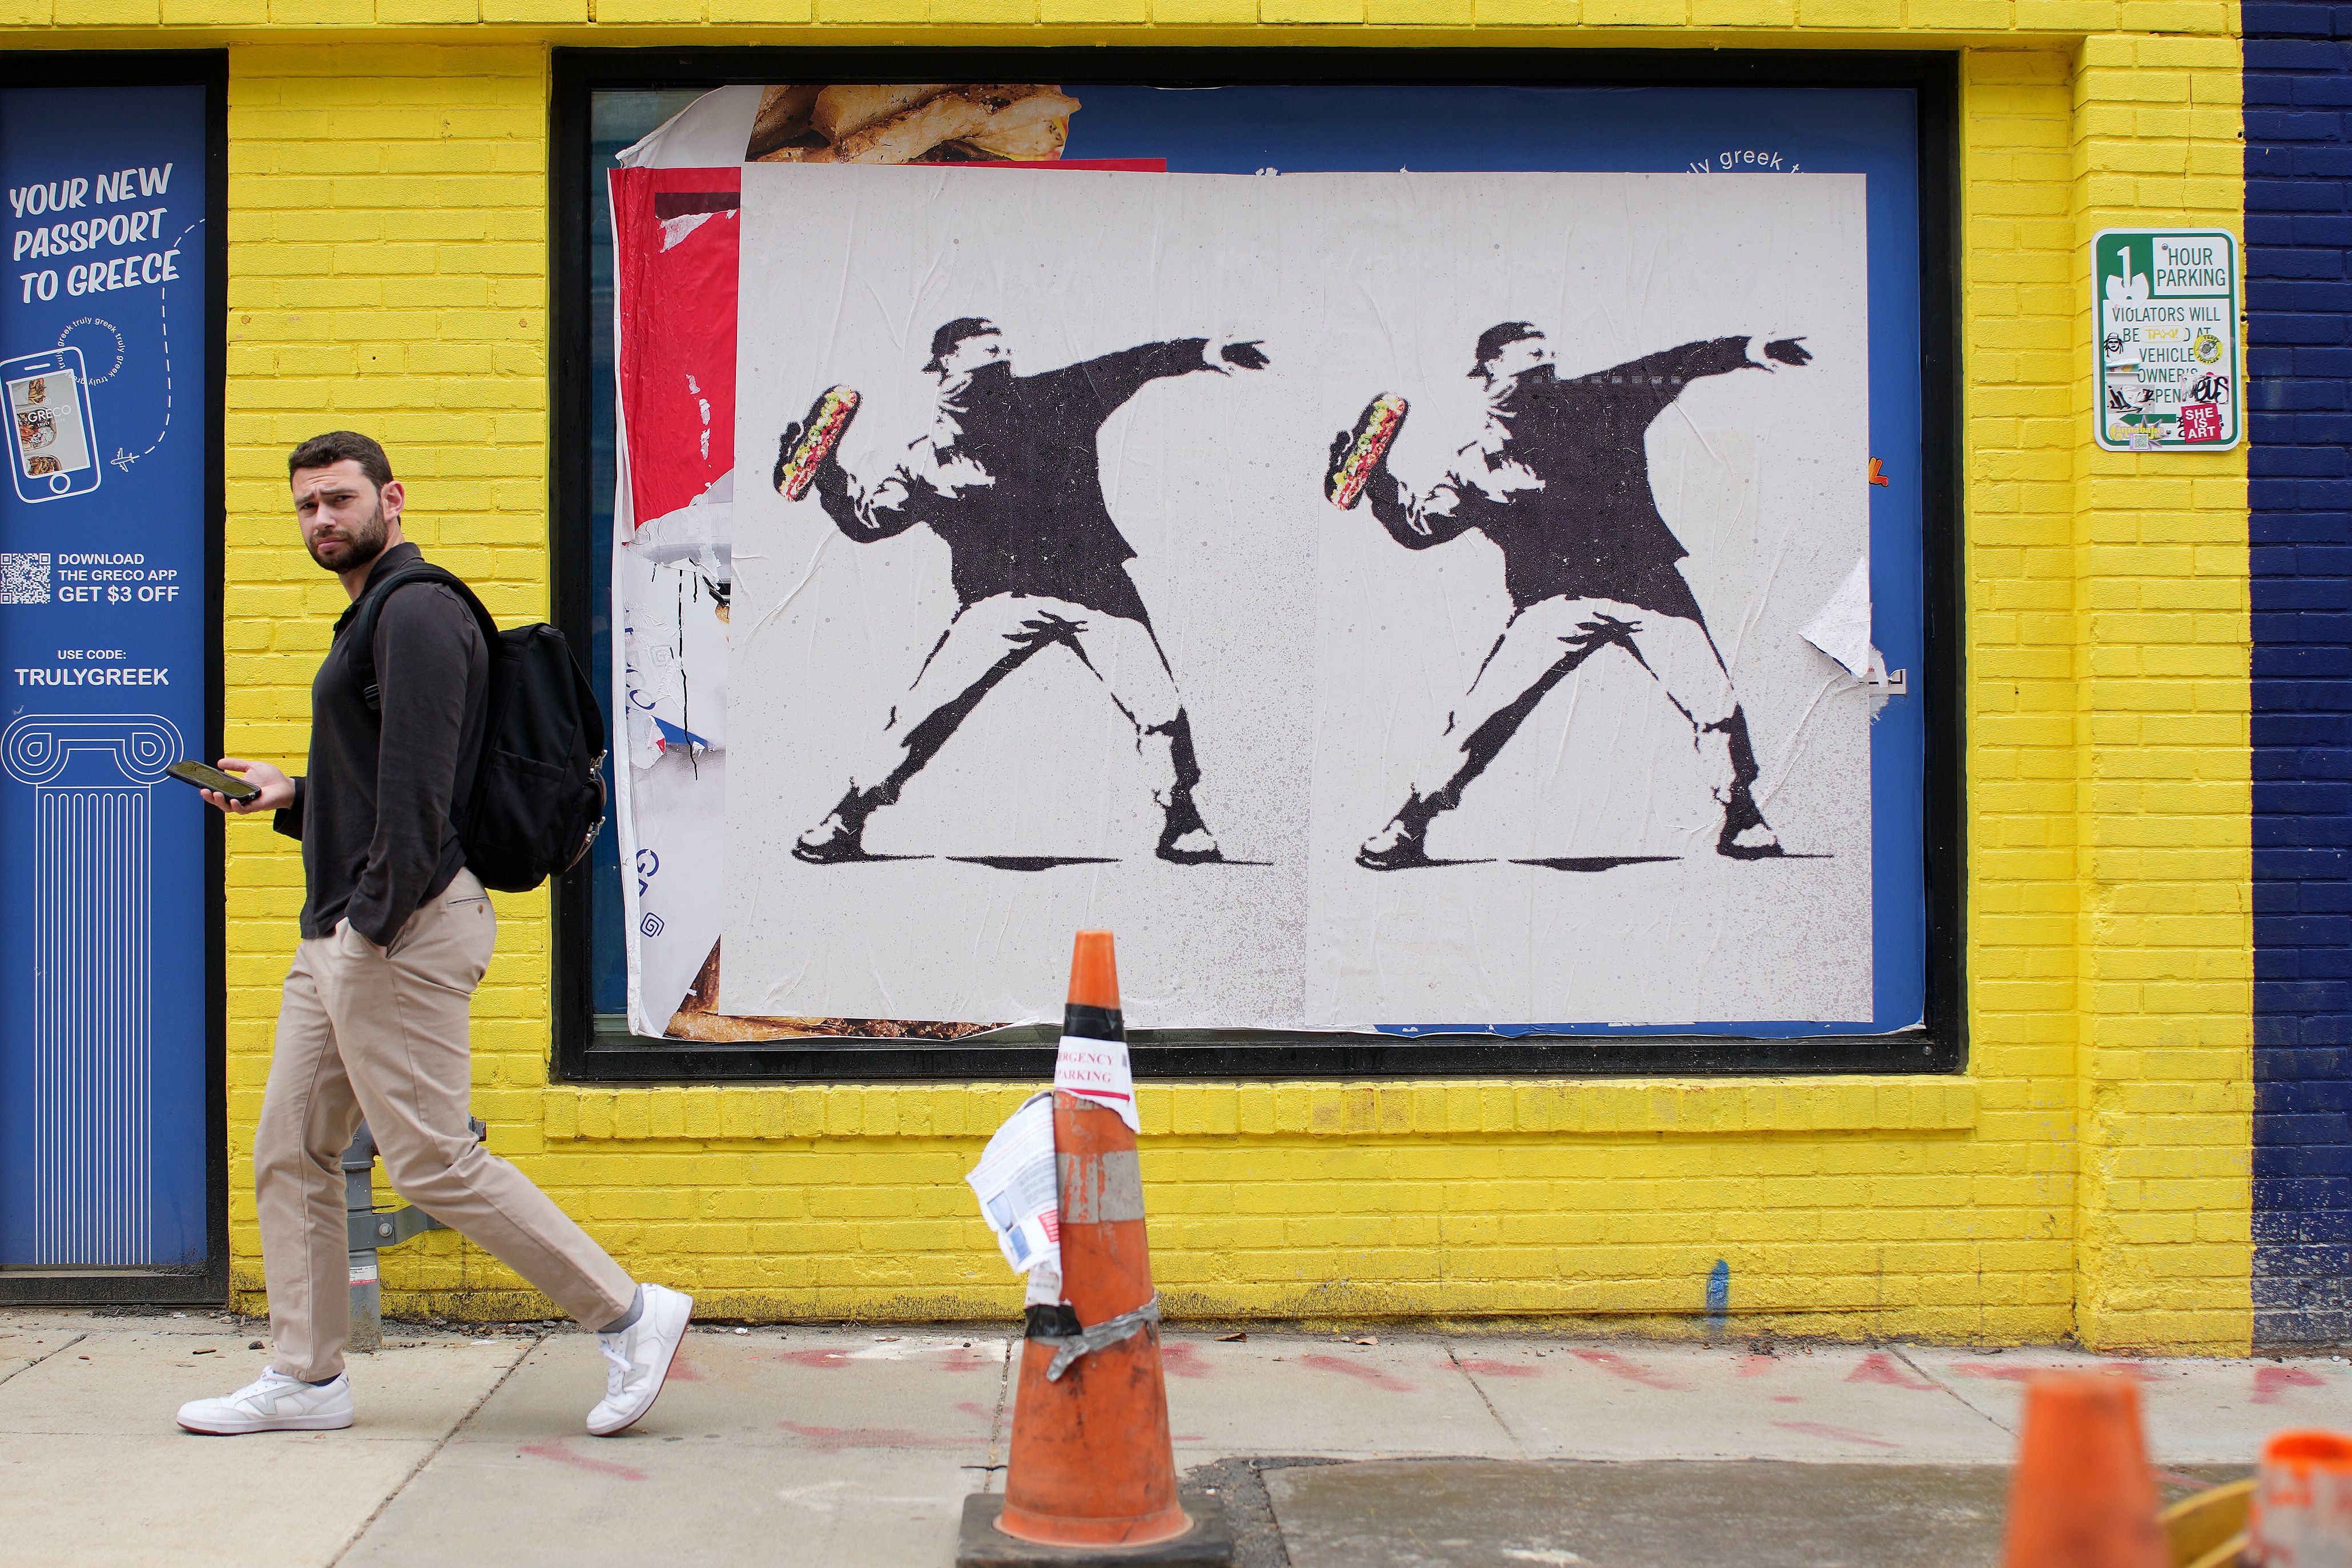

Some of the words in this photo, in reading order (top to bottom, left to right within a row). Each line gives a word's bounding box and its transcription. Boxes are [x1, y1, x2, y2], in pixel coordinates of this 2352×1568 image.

[1719, 150, 1783, 171] greek
[10, 178, 88, 218] YOUR
[96, 163, 173, 204] NEW
[13, 207, 167, 261] PASSPORT
[2117, 246, 2131, 288] 1
[2168, 248, 2213, 266] HOUR
[19, 270, 58, 304] TO
[67, 249, 181, 296] GREECE
[2157, 268, 2226, 287] PARKING
[73, 317, 92, 327] truly
[2112, 307, 2185, 322] VIOLATORS
[2189, 307, 2221, 321] WILL
[95, 318, 117, 333] greek
[58, 325, 74, 347] greek
[115, 333, 126, 353] truly
[2123, 328, 2140, 342] BE
[55, 350, 66, 369] truly
[2139, 348, 2196, 362] VEHICLE
[108, 355, 124, 377] greek
[88, 376, 108, 386] truly
[27, 404, 71, 422] GRECO
[2185, 407, 2214, 421] SHE
[2193, 418, 2208, 429] IS
[2188, 426, 2216, 439] ART
[58, 553, 144, 565] DOWNLOAD
[58, 570, 87, 581] THE
[91, 570, 144, 581] GRECO
[148, 570, 178, 581] APP
[58, 586, 102, 602] GET
[107, 585, 132, 606] $3
[138, 586, 180, 602] OFF
[58, 650, 84, 660] USE
[86, 650, 127, 660] CODE:
[14, 668, 170, 686] TRULYGREEK
[1057, 1051, 1114, 1065] ERGENCY
